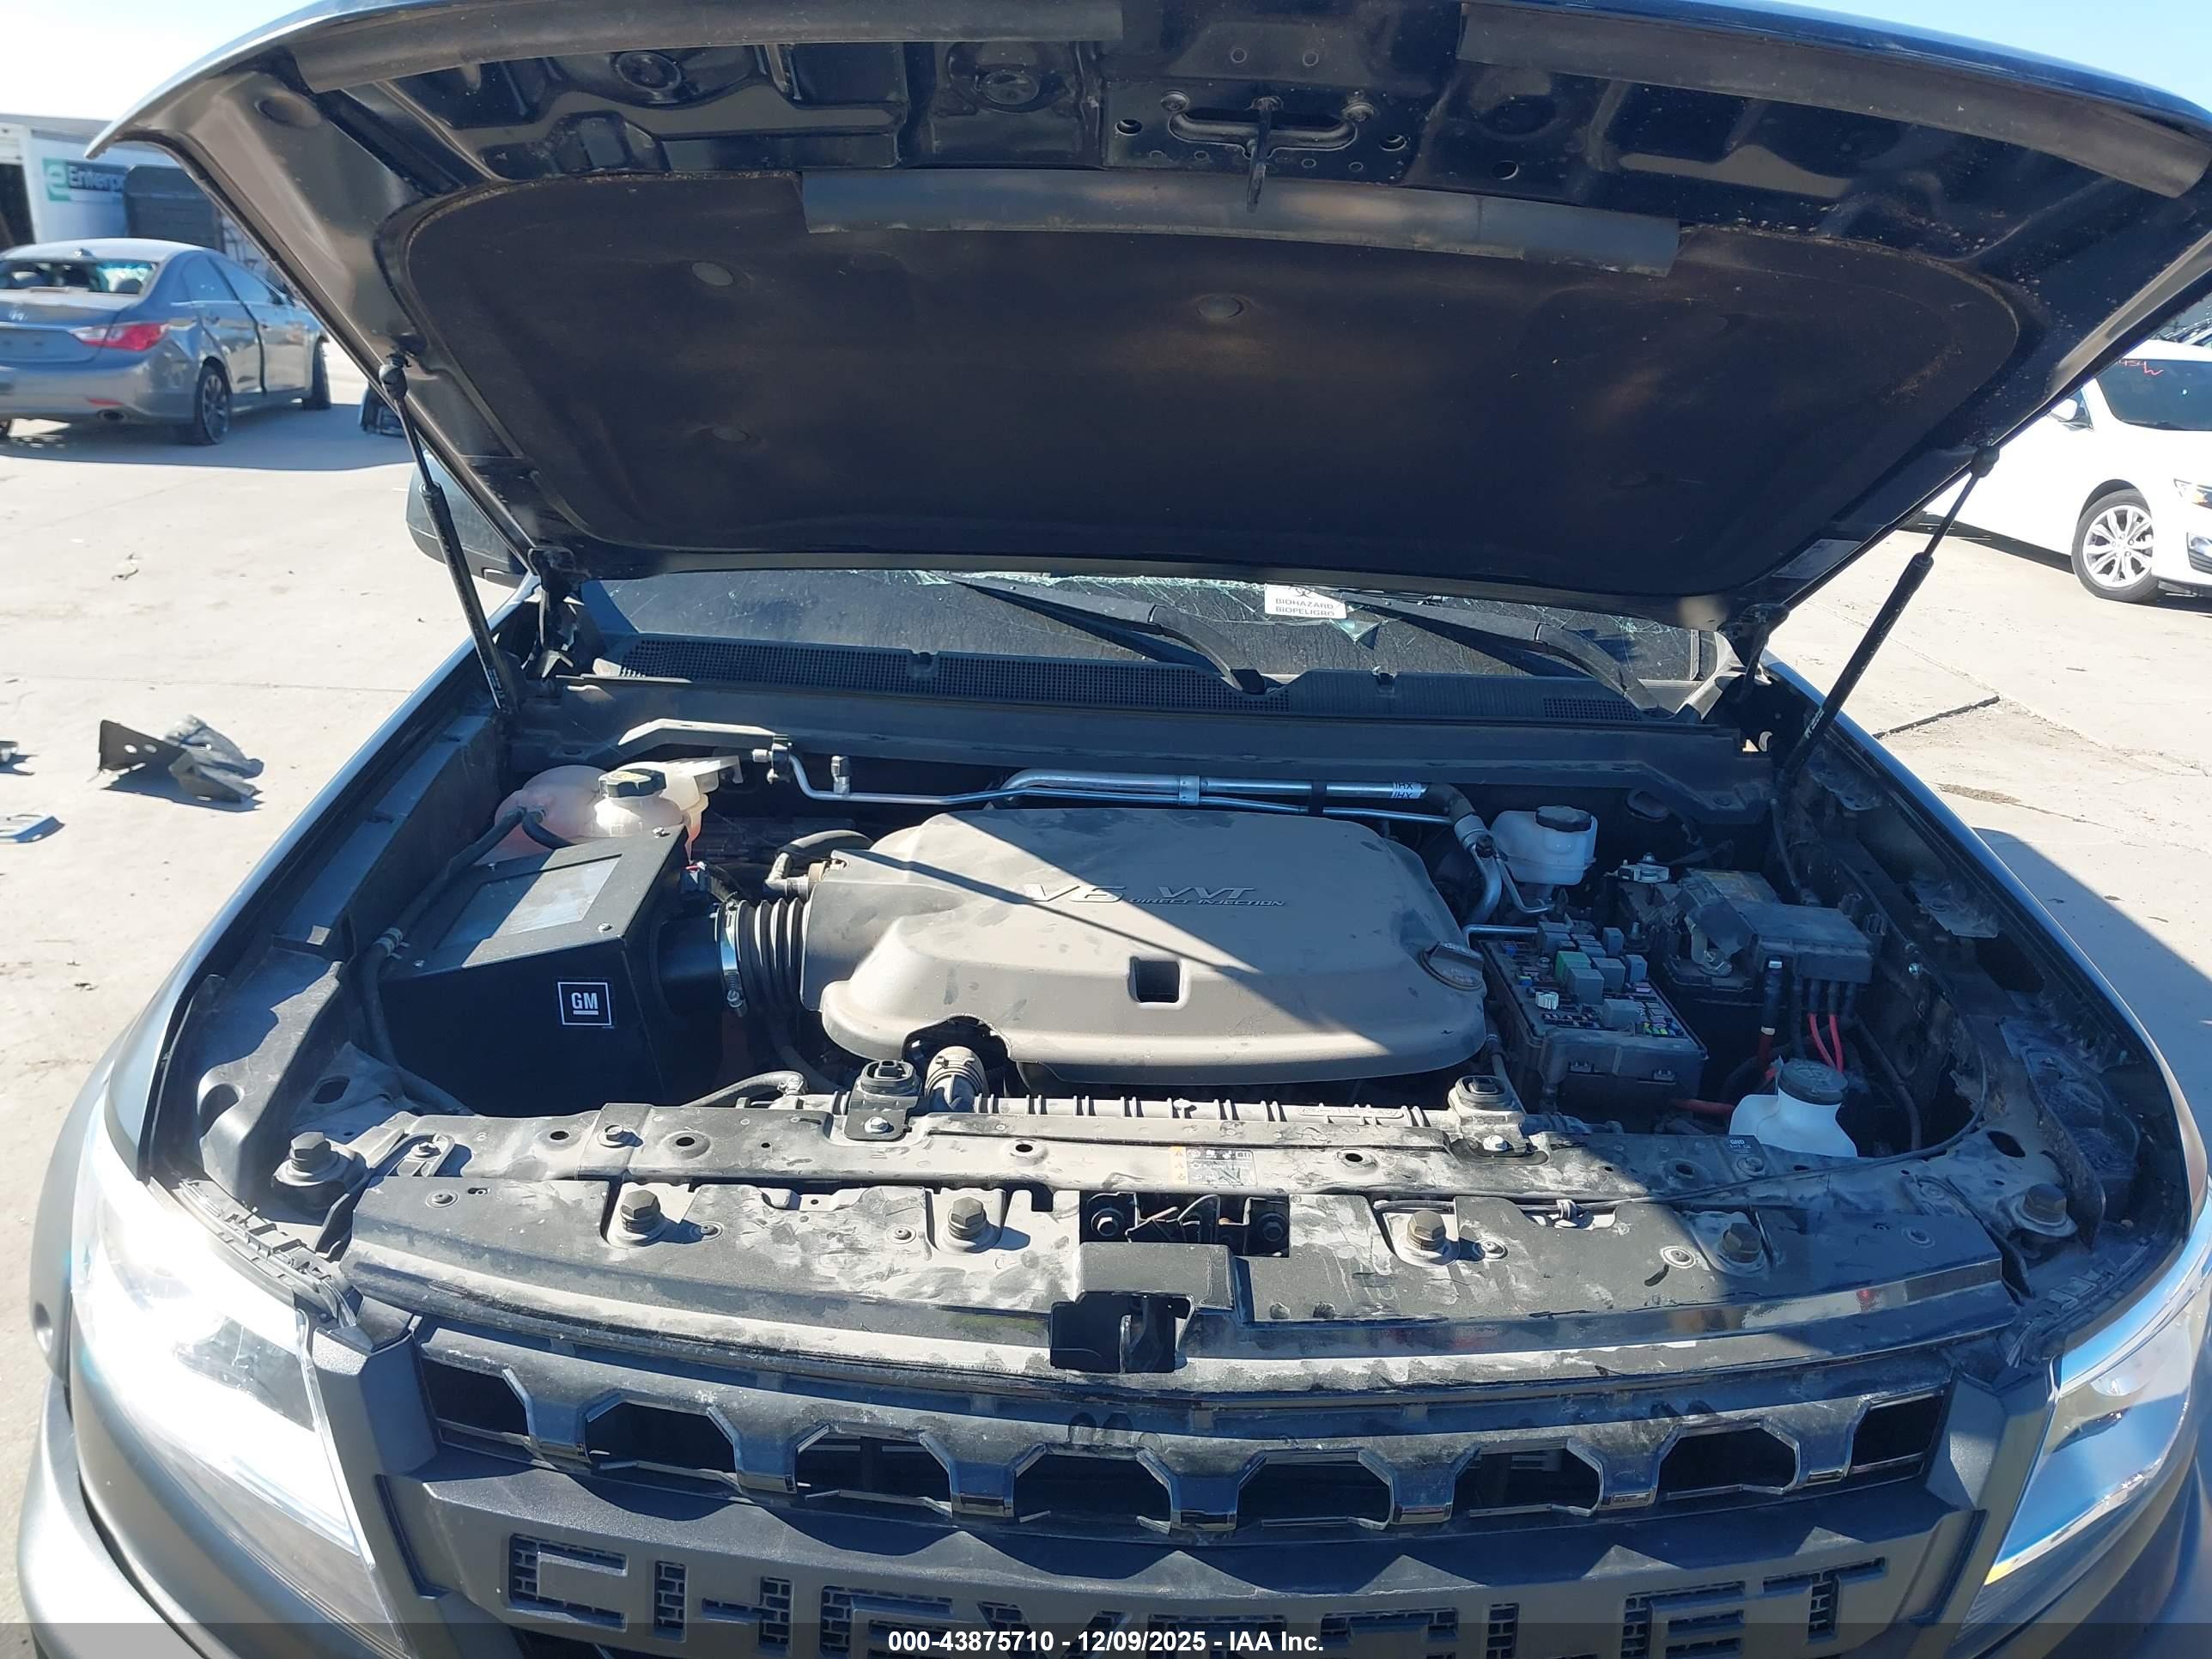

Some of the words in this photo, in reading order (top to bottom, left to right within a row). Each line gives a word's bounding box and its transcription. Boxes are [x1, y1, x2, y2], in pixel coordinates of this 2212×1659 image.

[68, 165, 124, 192] Enterp
[1275, 598, 1334, 610] BIOHAZARD
[1275, 605, 1335, 617] BIOPELIGRO
[1024, 883, 1126, 902] V6
[1157, 885, 1256, 900] VVT
[570, 992, 599, 1010] GM
